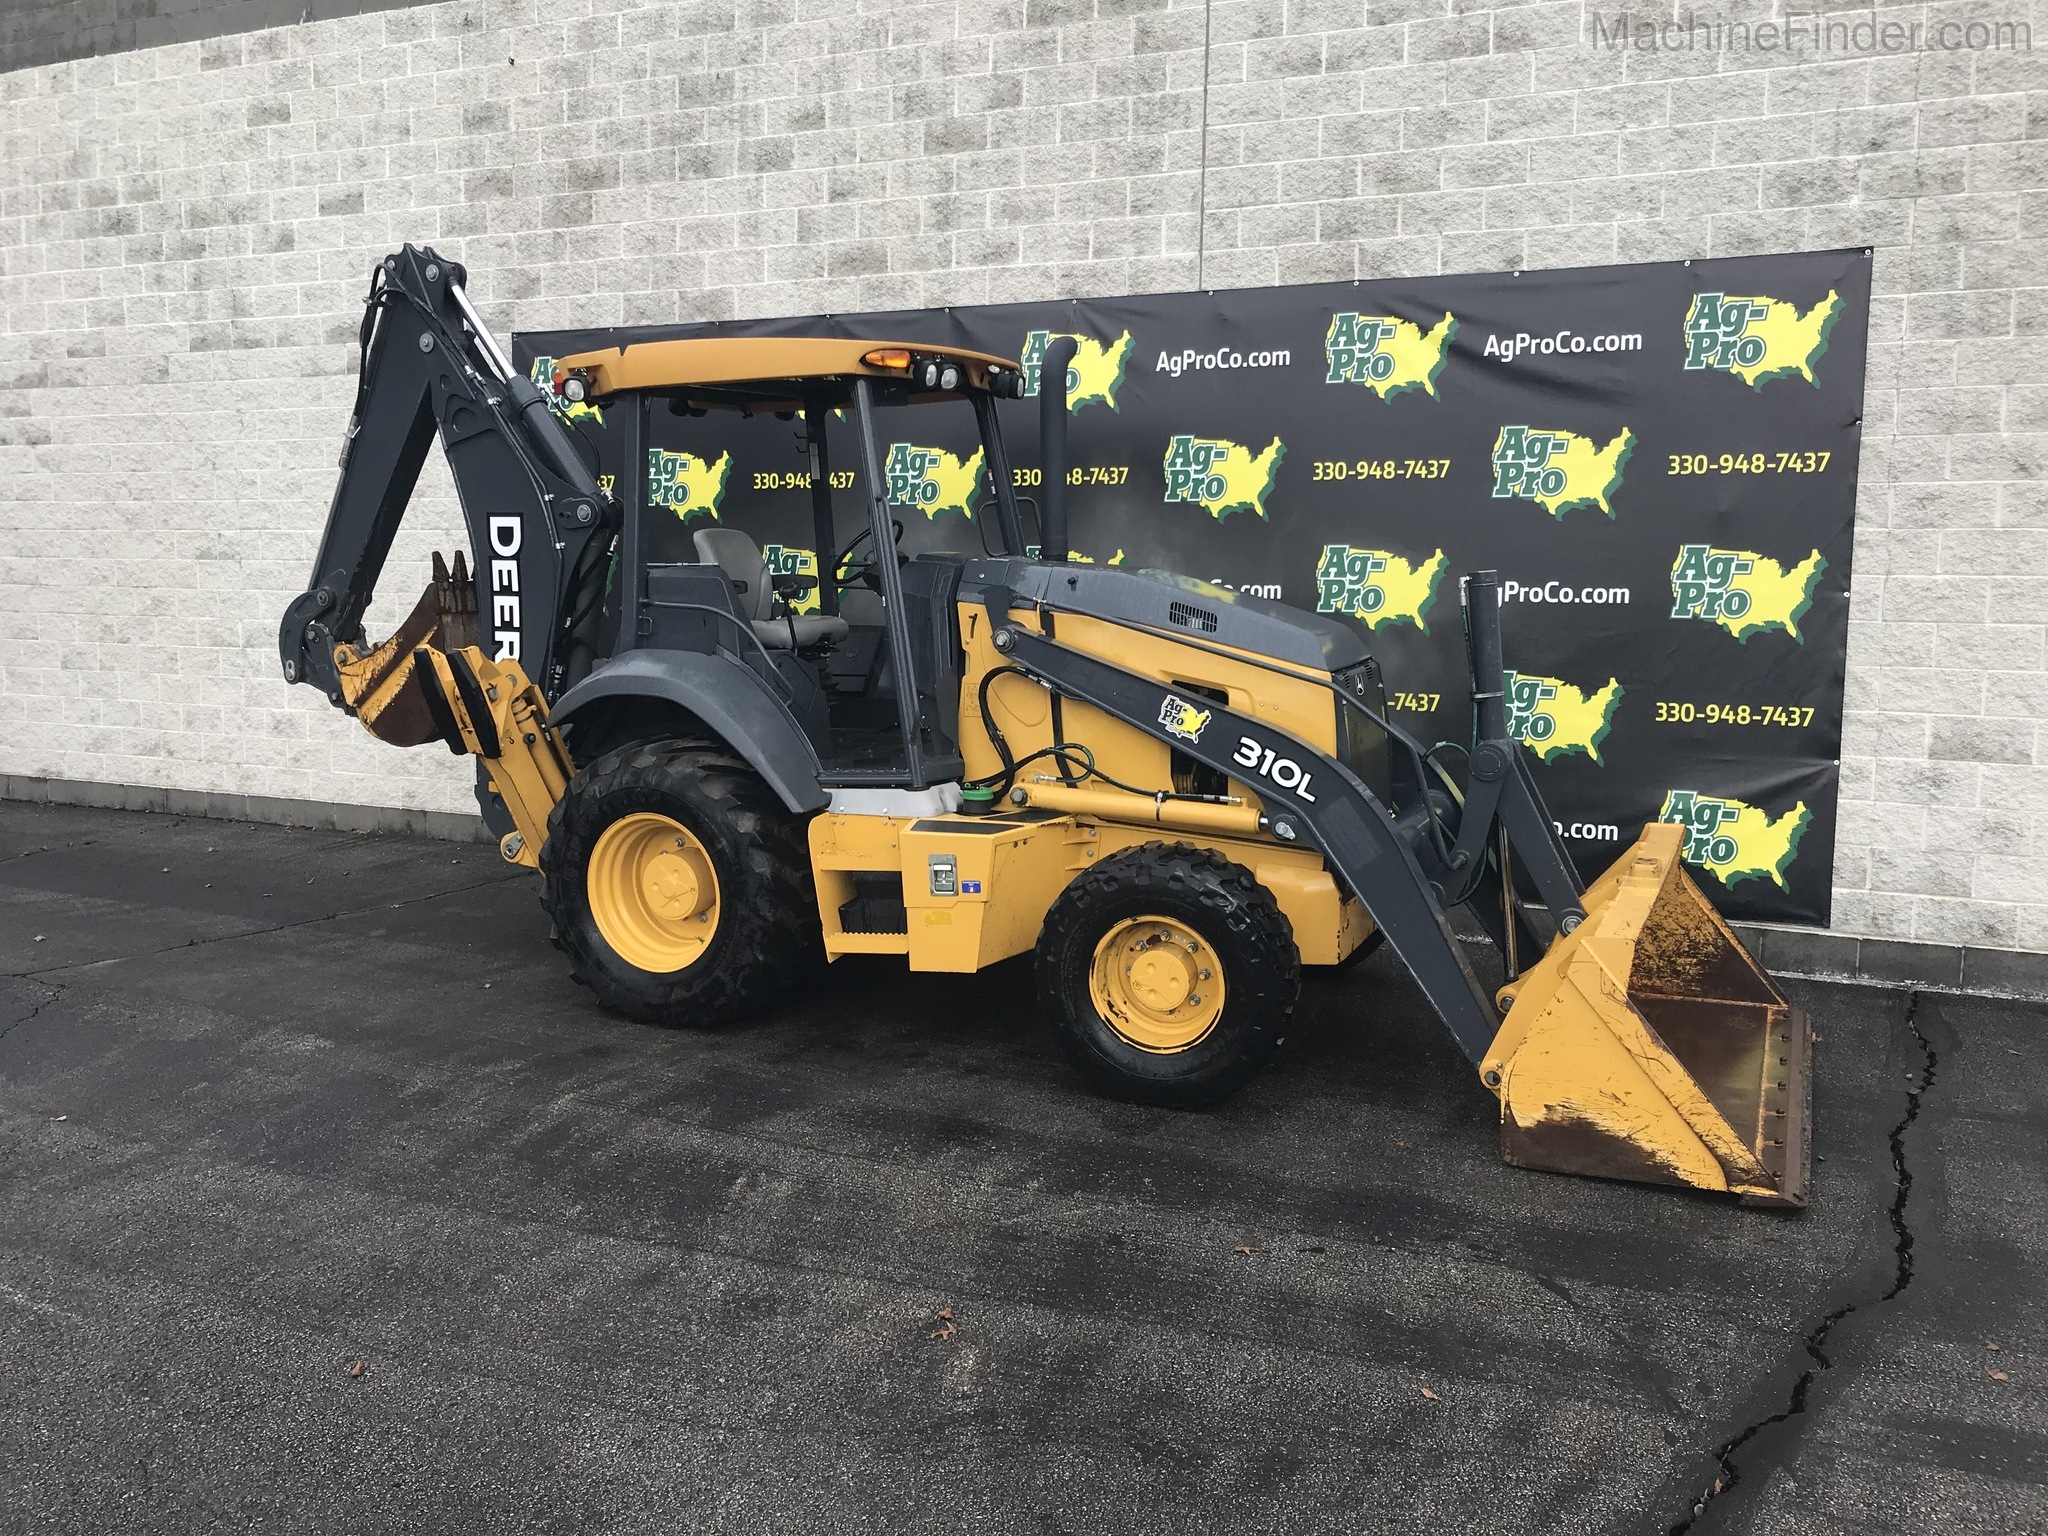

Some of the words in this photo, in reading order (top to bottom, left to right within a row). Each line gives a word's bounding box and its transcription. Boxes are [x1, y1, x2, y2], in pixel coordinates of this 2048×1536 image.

[1328, 312, 1395, 350] Ag-
[1686, 293, 1768, 338] Ag-
[1155, 347, 1291, 378] AgProCo.com
[1483, 330, 1643, 362] AgProCo.com
[1684, 331, 1765, 369] Pro
[1024, 364, 1080, 396] Po
[1326, 347, 1394, 384] Pro
[888, 443, 940, 477] Ag-
[1167, 435, 1227, 474] Ag-
[1496, 425, 1568, 467] Ag-
[1312, 460, 1451, 481] 330-948-7437
[1492, 462, 1567, 498] Pro
[1667, 452, 1831, 475] 330-948-7437
[648, 478, 690, 506] Pro
[888, 474, 940, 505] Pro
[1165, 469, 1227, 503] Pro
[1320, 545, 1386, 585] Ag-
[1674, 544, 1752, 585] Ag-
[1317, 582, 1384, 613] Pro
[1671, 581, 1750, 619] Pro
[1161, 709, 1185, 726] Pro
[1164, 698, 1187, 715] Ag-
[1655, 702, 1814, 727] 330-948-7437
[1232, 736, 1316, 803] 310L
[1664, 790, 1740, 835] Ag-
